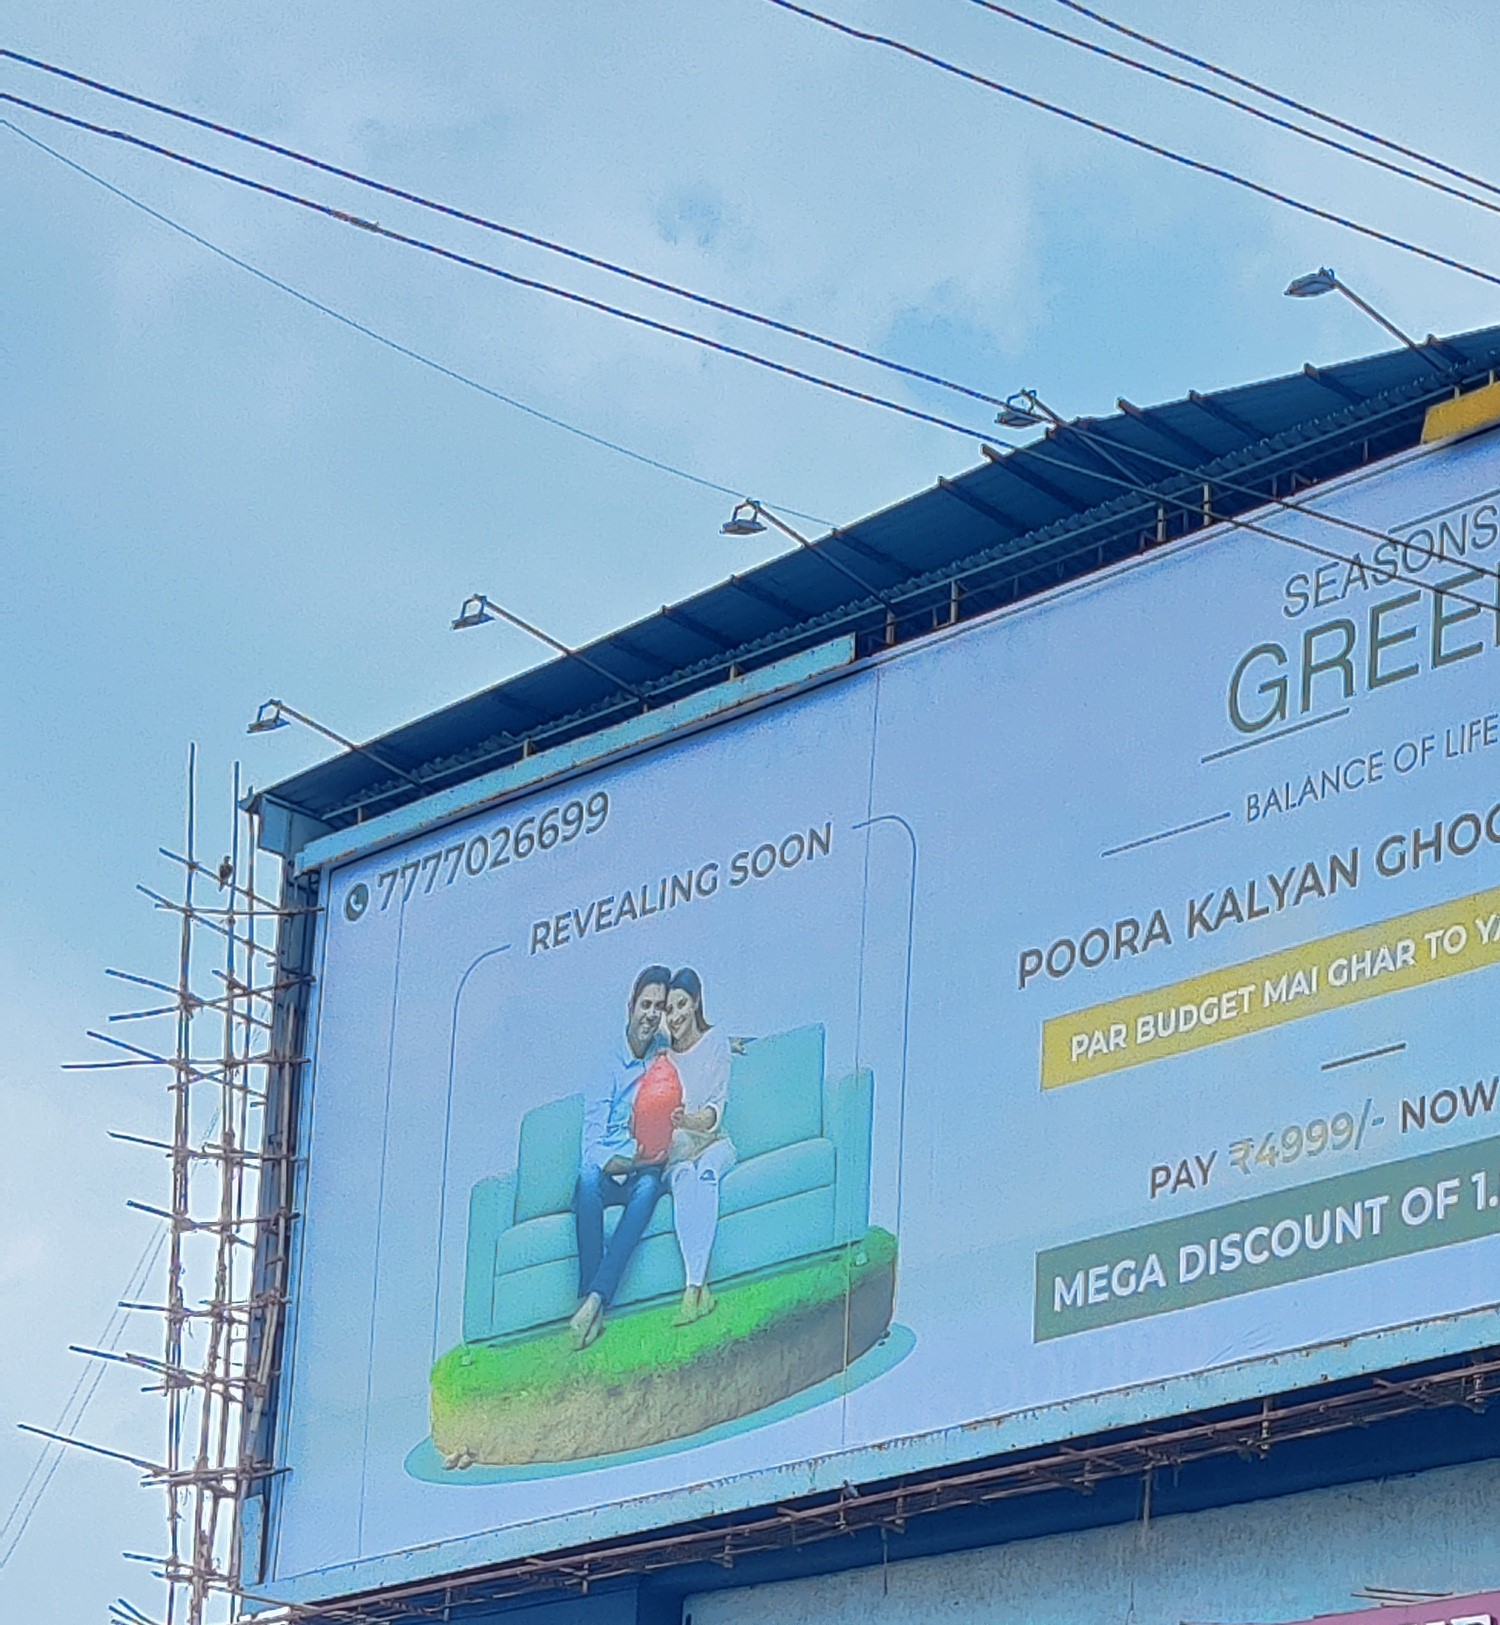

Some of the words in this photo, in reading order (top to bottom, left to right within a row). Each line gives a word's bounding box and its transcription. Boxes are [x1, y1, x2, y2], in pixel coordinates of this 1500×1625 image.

[1283, 504, 1500, 619] SEASONS
[1245, 749, 1384, 824] BALANCE
[1393, 738, 1436, 775] OF
[1444, 714, 1500, 762] LIFE
[377, 791, 612, 912] 7777026699
[530, 863, 718, 956] REVEALING
[729, 822, 834, 891] SOON
[1018, 908, 1172, 990] POORA
[1187, 847, 1360, 940] KALYAN
[1070, 1027, 1127, 1063] PAR
[1135, 985, 1256, 1045] BUDGET
[1263, 968, 1319, 1009] MAI
[1328, 937, 1416, 989] GHAR
[1425, 924, 1467, 958] TO
[1150, 1150, 1218, 1199] PAY
[1228, 1097, 1386, 1176] ₹4999/-
[1400, 1075, 1500, 1134] NOW
[1053, 1254, 1167, 1314] MEGA
[1178, 1195, 1390, 1285] DISCOUNT
[1400, 1184, 1461, 1229] OF
